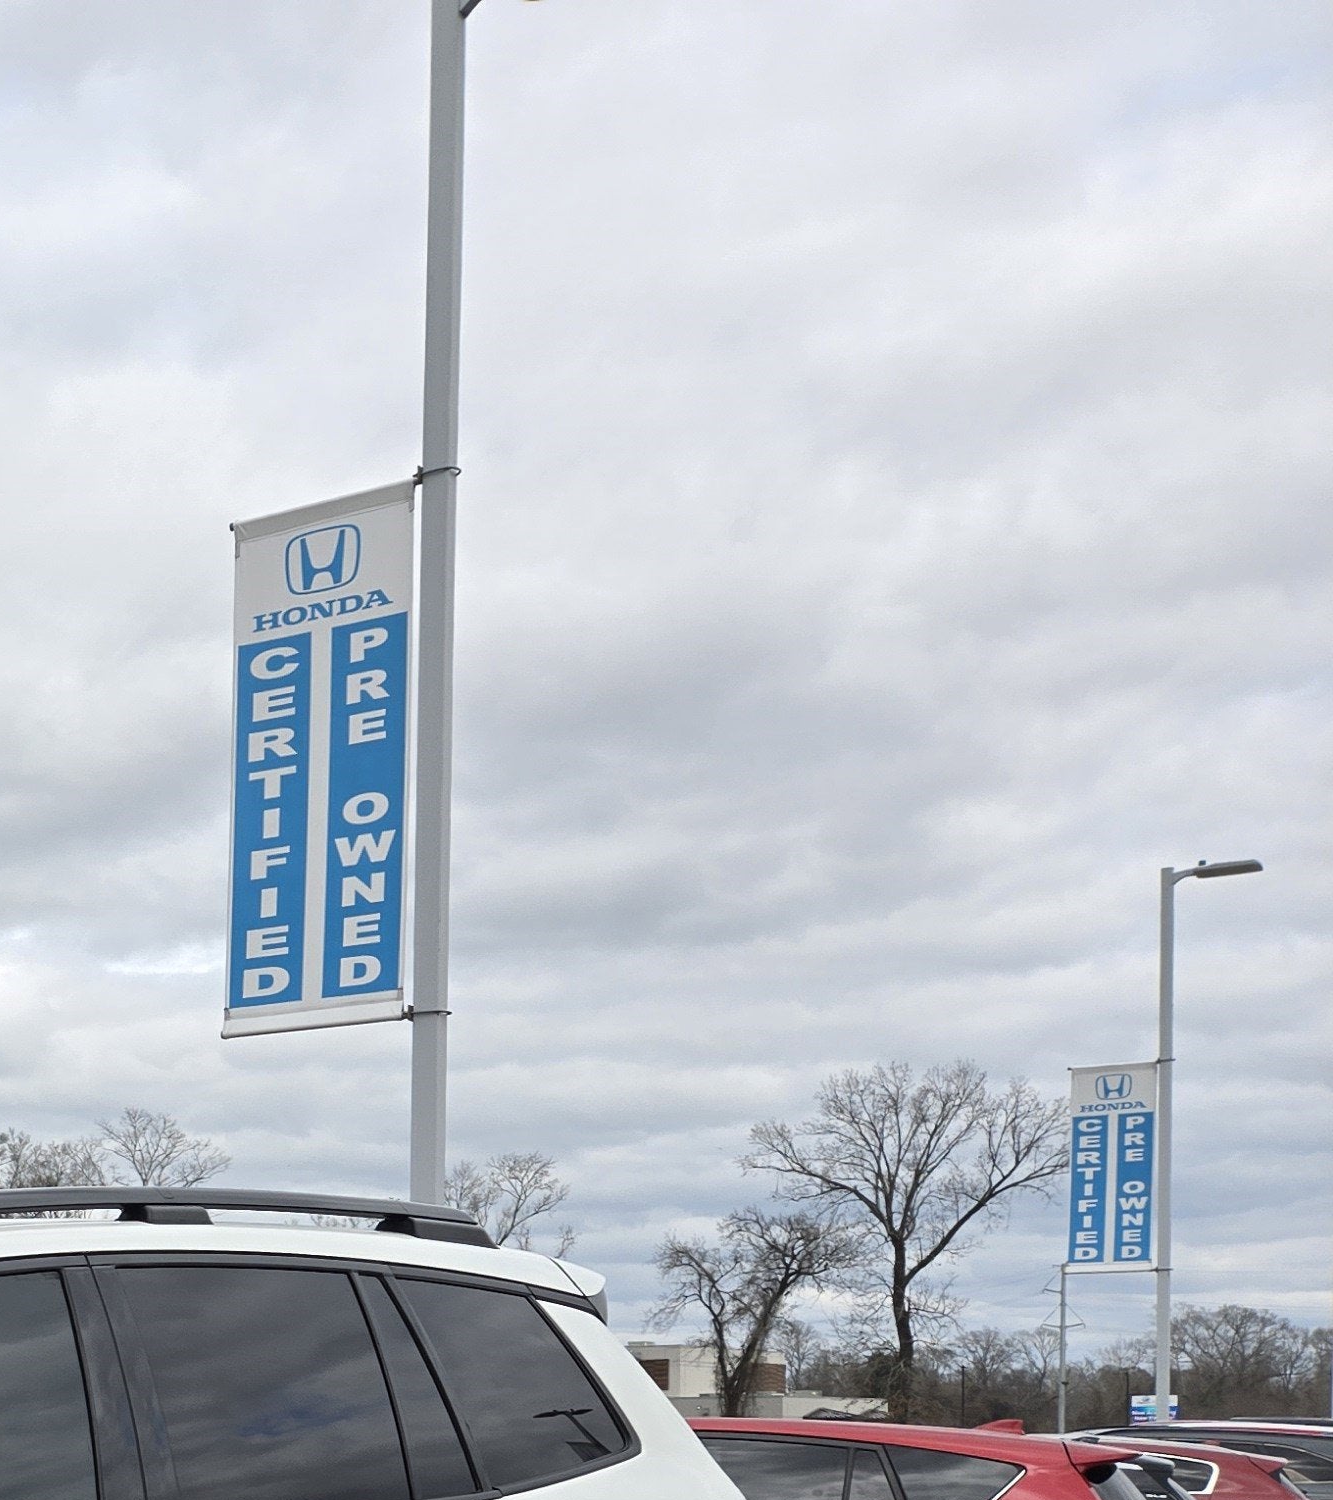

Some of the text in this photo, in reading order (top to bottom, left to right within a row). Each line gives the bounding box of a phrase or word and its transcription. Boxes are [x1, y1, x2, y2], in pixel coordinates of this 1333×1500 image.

[252, 588, 394, 633] HONDA
[242, 646, 301, 999] CERTIFIED
[334, 625, 397, 988] PRE OWNED
[1079, 1100, 1147, 1113] HONDA
[1073, 1118, 1103, 1261] CERTIFIED
[1118, 1115, 1149, 1259] PRE OWNED
